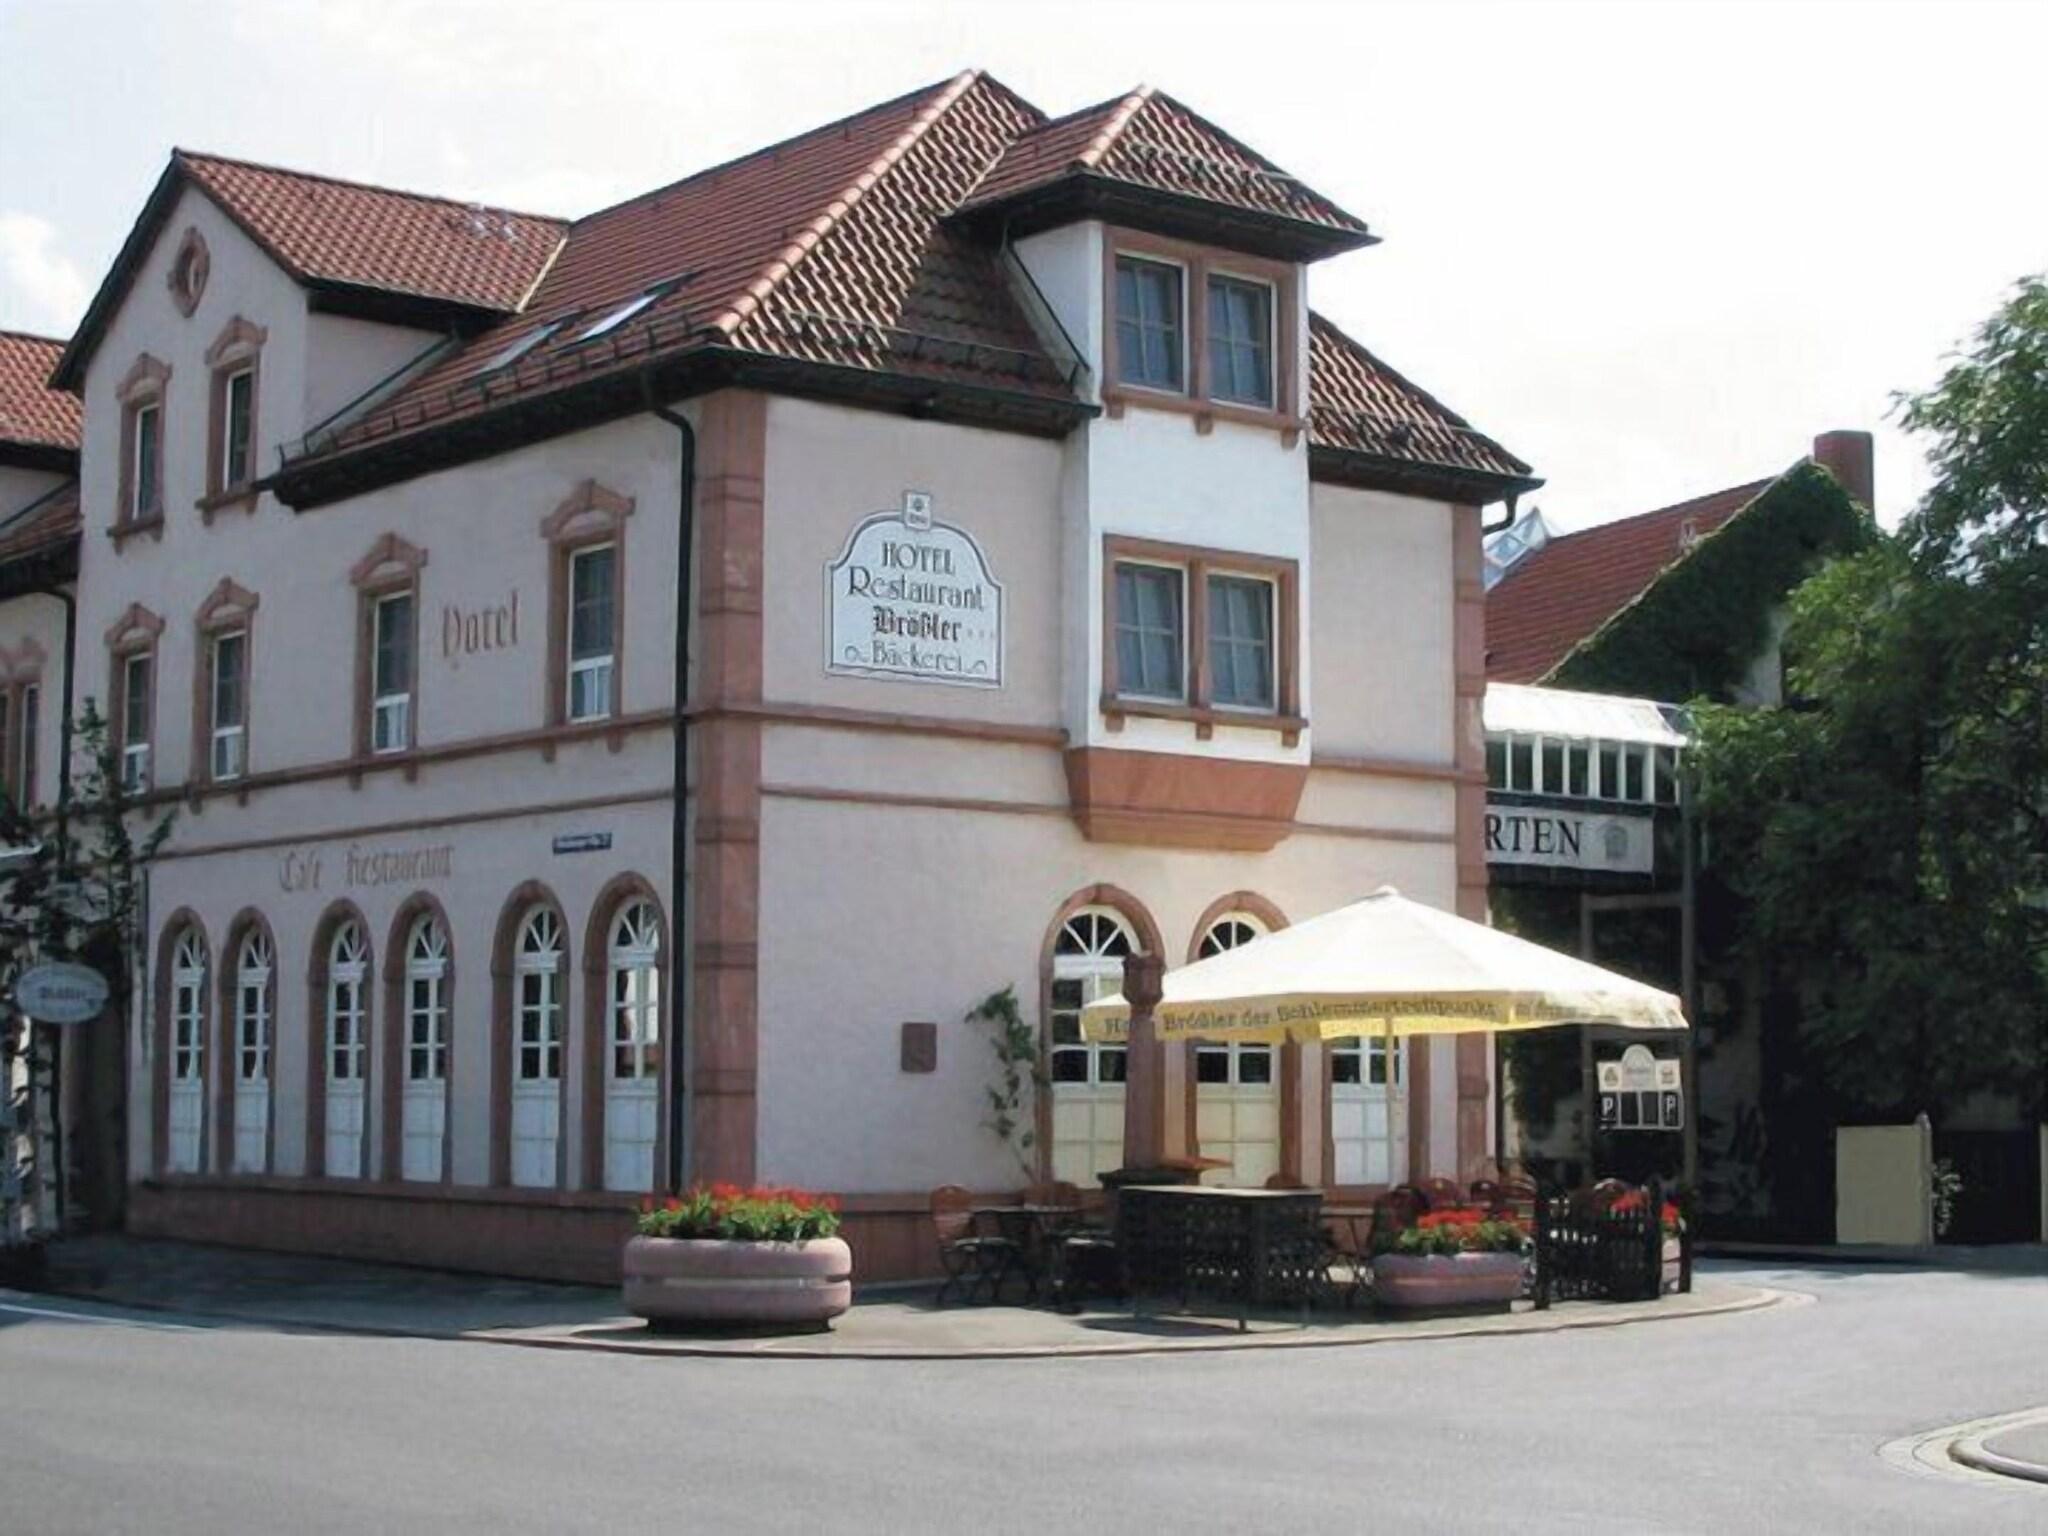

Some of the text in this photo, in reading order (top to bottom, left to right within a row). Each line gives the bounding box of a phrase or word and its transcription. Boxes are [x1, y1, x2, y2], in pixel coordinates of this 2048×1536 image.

[881, 541, 955, 575] HOTEL
[846, 565, 985, 612] Restaurant
[1484, 813, 1582, 858] RTEN
